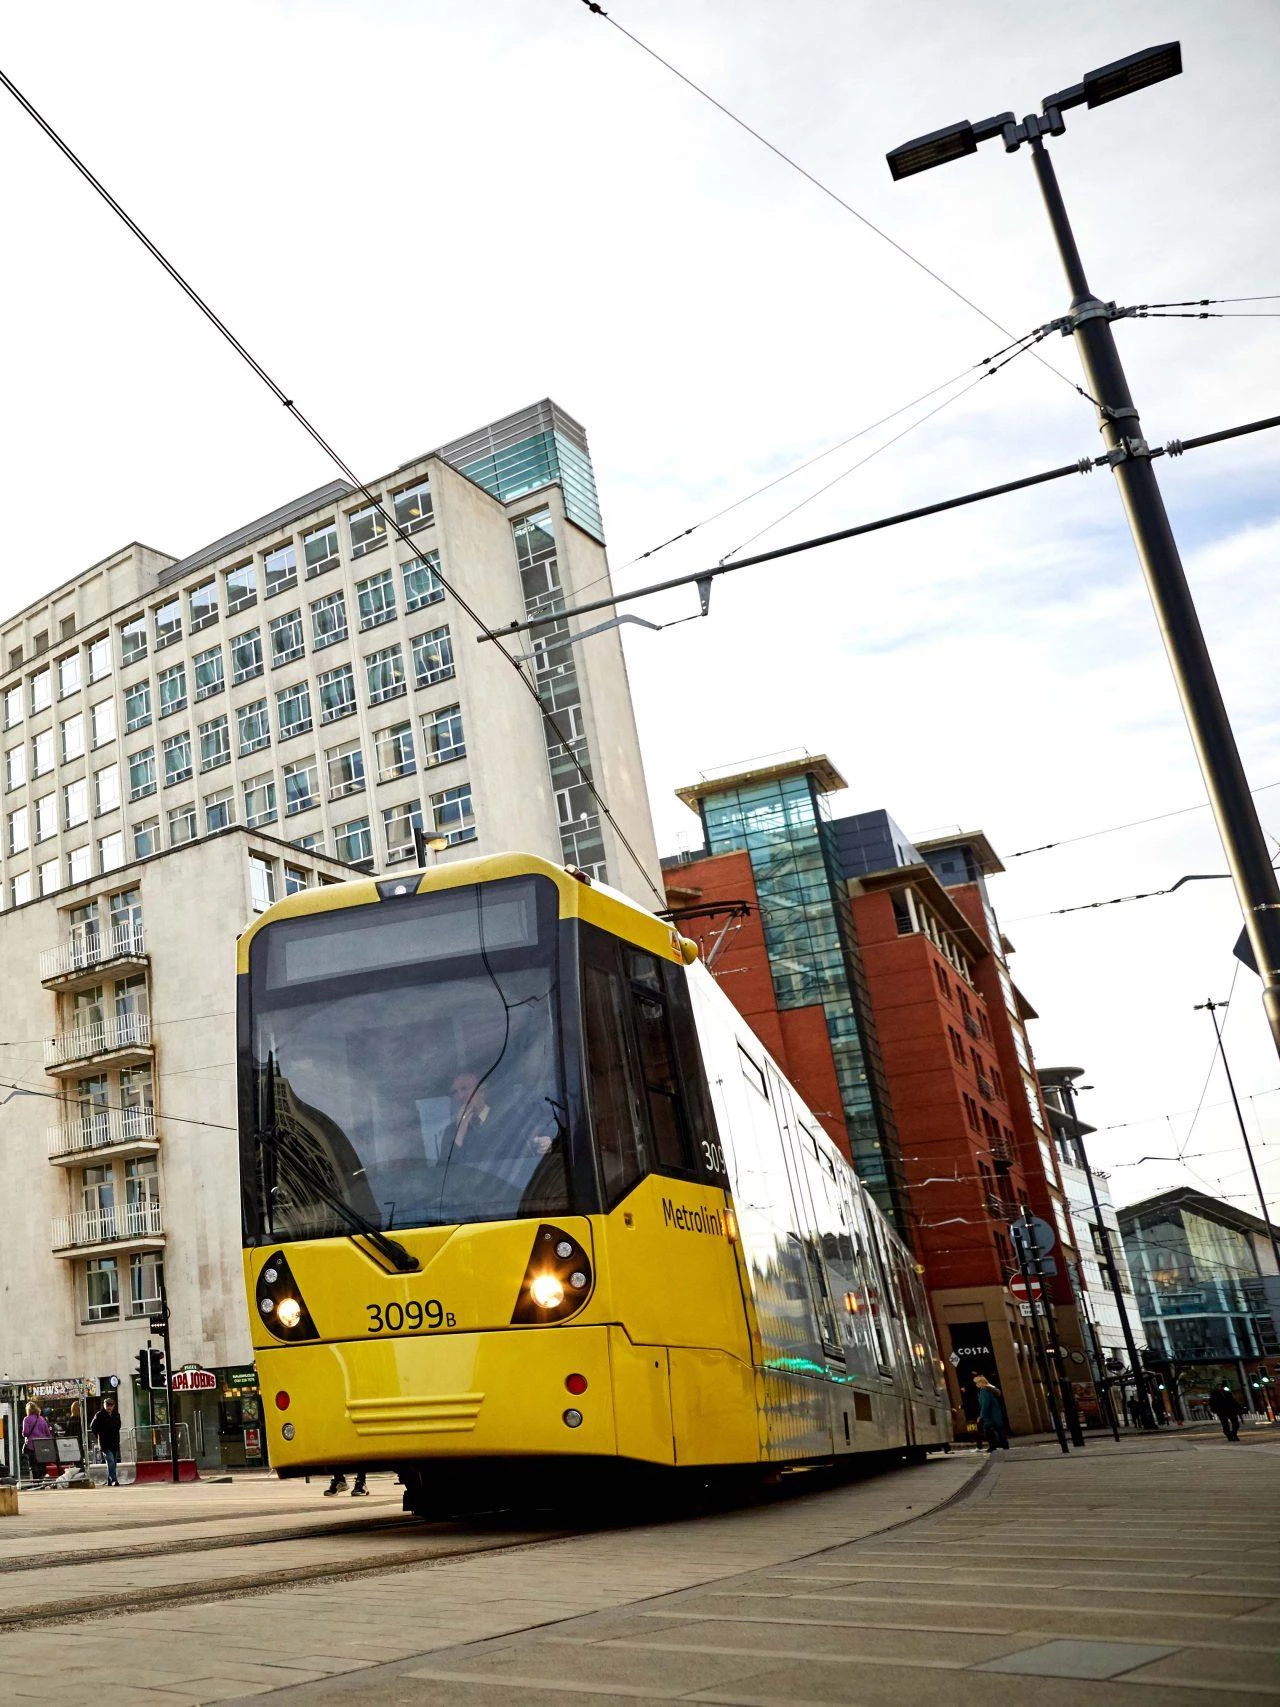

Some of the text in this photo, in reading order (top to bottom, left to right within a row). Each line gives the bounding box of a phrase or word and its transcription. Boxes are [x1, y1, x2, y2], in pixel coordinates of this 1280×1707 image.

[957, 1346, 990, 1355] COSTA
[172, 1372, 189, 1390] APA
[32, 1385, 59, 1396] NEWS
